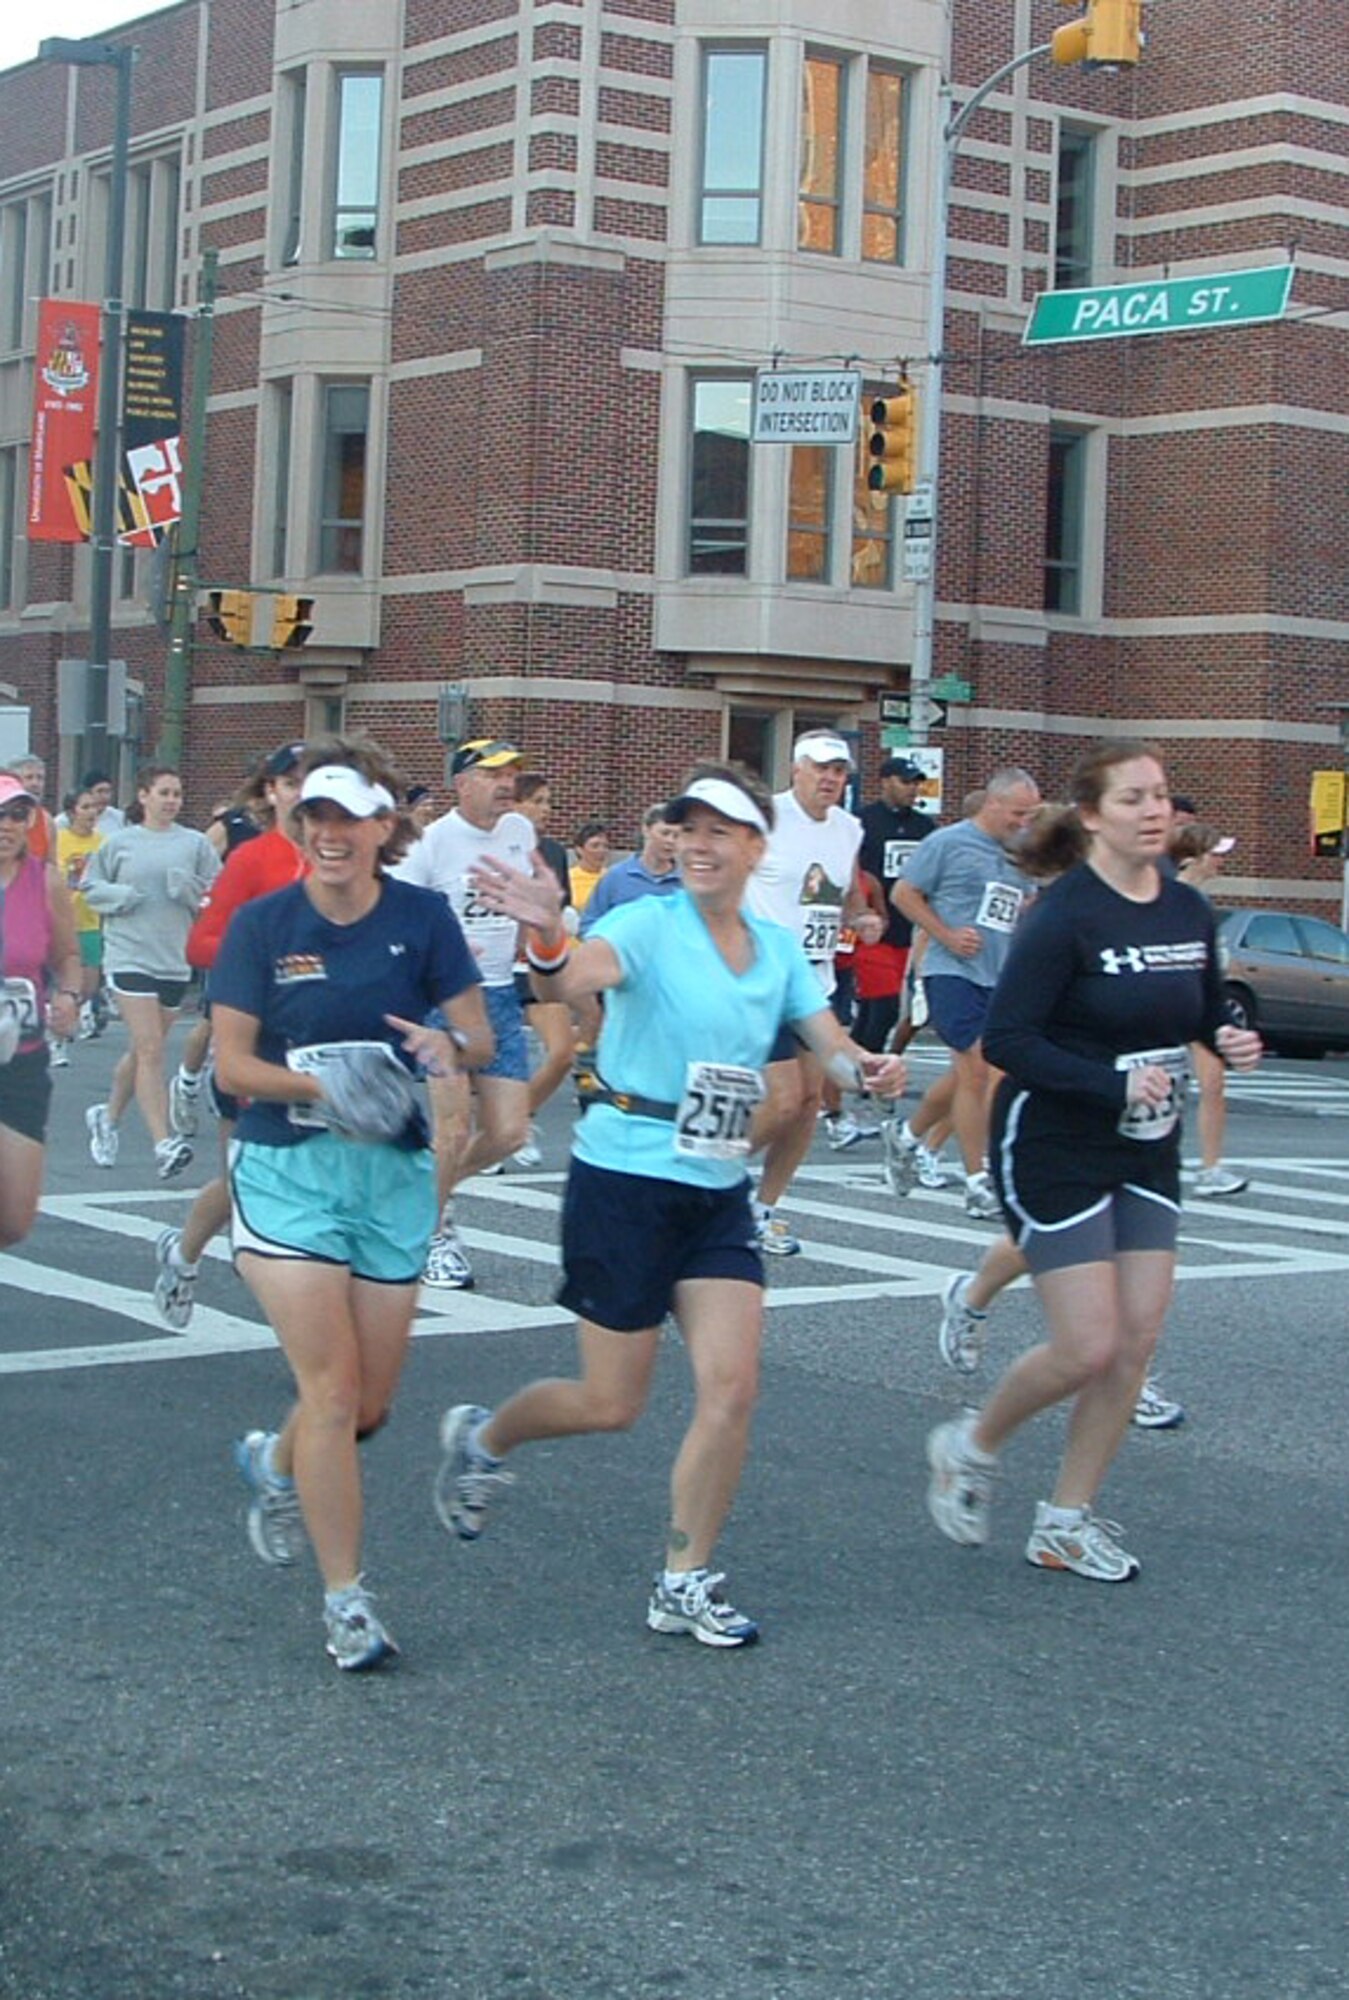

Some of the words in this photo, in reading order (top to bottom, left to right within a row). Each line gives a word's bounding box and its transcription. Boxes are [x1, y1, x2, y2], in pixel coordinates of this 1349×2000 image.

[1072, 291, 1169, 331] PACA
[1187, 287, 1239, 315] ST.
[761, 381, 779, 402] DO
[782, 381, 808, 402] NOT
[811, 380, 857, 402] BLOCK
[760, 412, 850, 432] INTERSECTION
